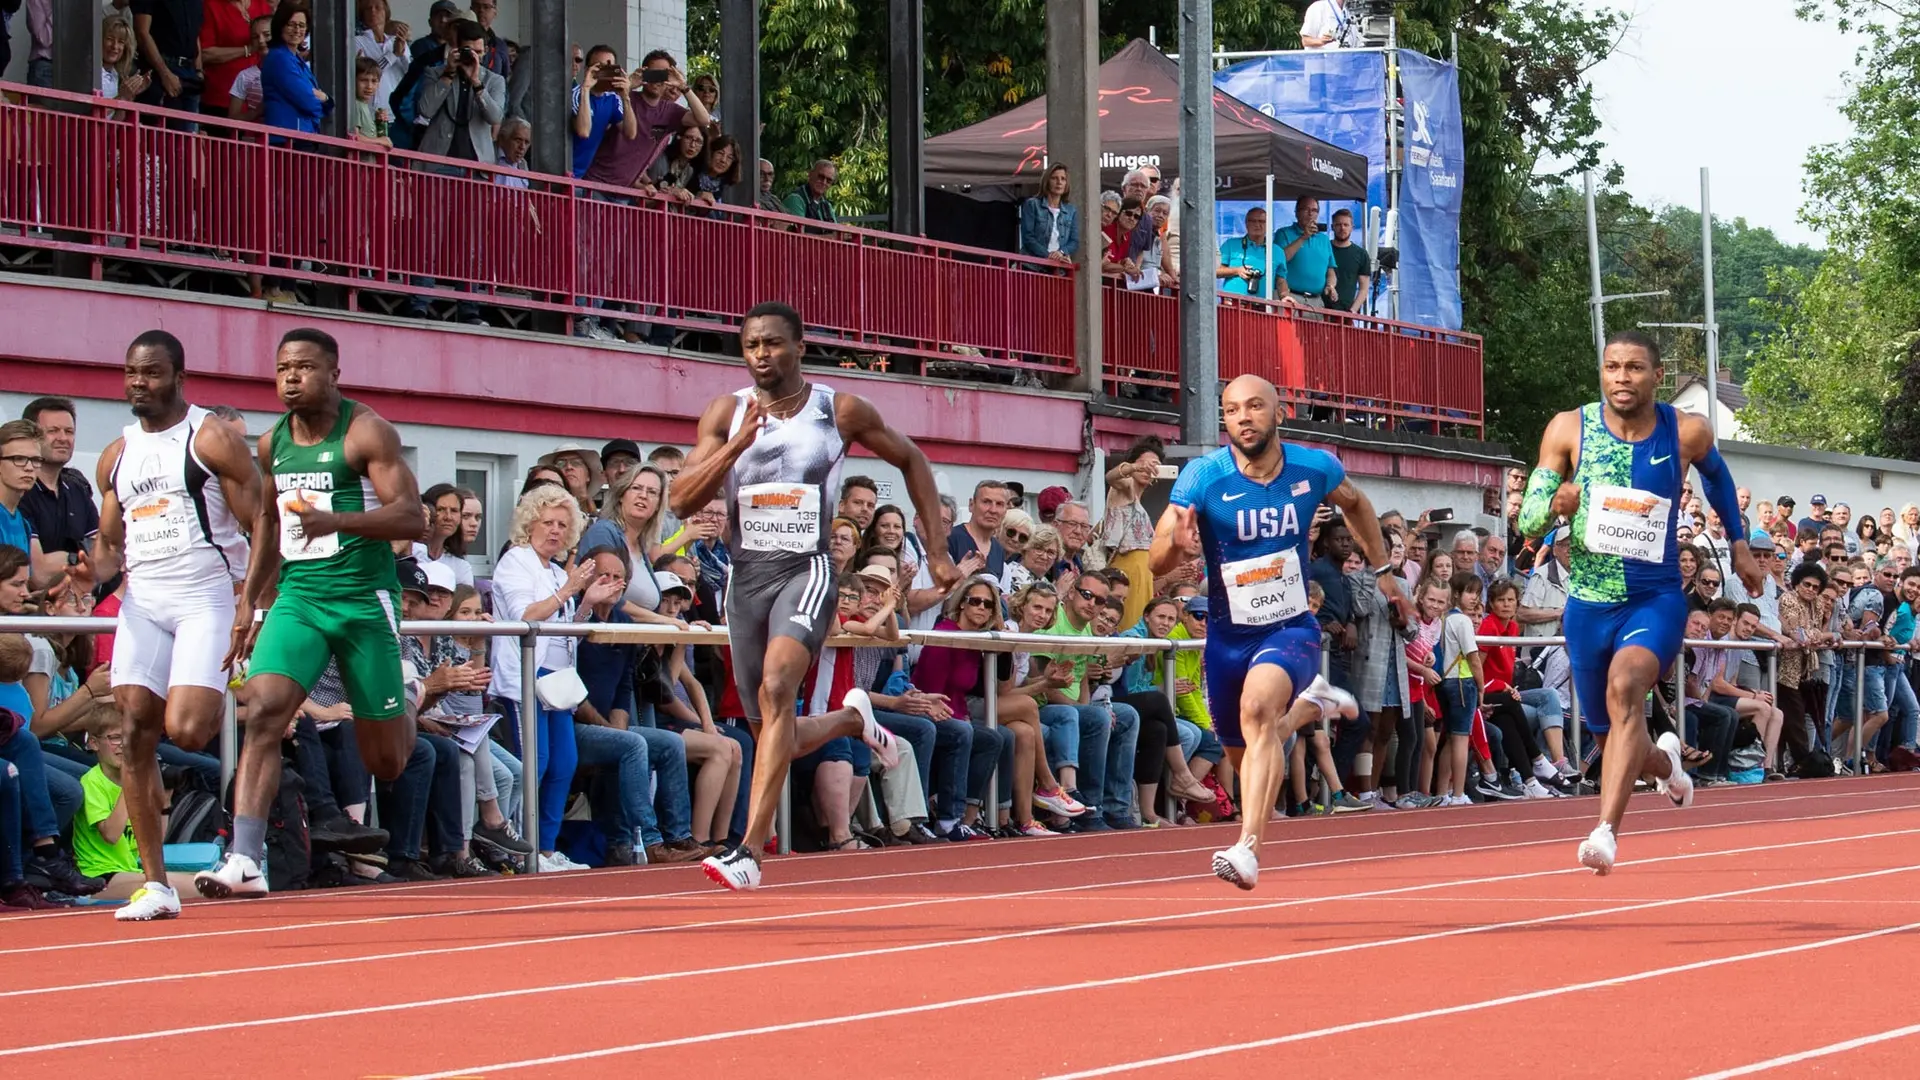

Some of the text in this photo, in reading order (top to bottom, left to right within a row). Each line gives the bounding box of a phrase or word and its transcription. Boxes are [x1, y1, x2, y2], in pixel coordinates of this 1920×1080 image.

[1100, 152, 1160, 171] lingen
[274, 471, 334, 491] NIGERIA
[165, 515, 185, 526] 144
[796, 511, 817, 521] 139
[1237, 503, 1300, 541] USA
[744, 520, 815, 534] OGUNLEWE
[1597, 523, 1656, 543] RODRIGO
[1645, 519, 1666, 531] 140
[134, 528, 180, 544] WILLIAMS
[754, 538, 804, 549] REHLINGEN
[1598, 542, 1650, 558] REHLINGEN
[1281, 573, 1300, 588] 137
[1249, 591, 1286, 609] GRAY
[1246, 605, 1297, 624] REHLINGEN
